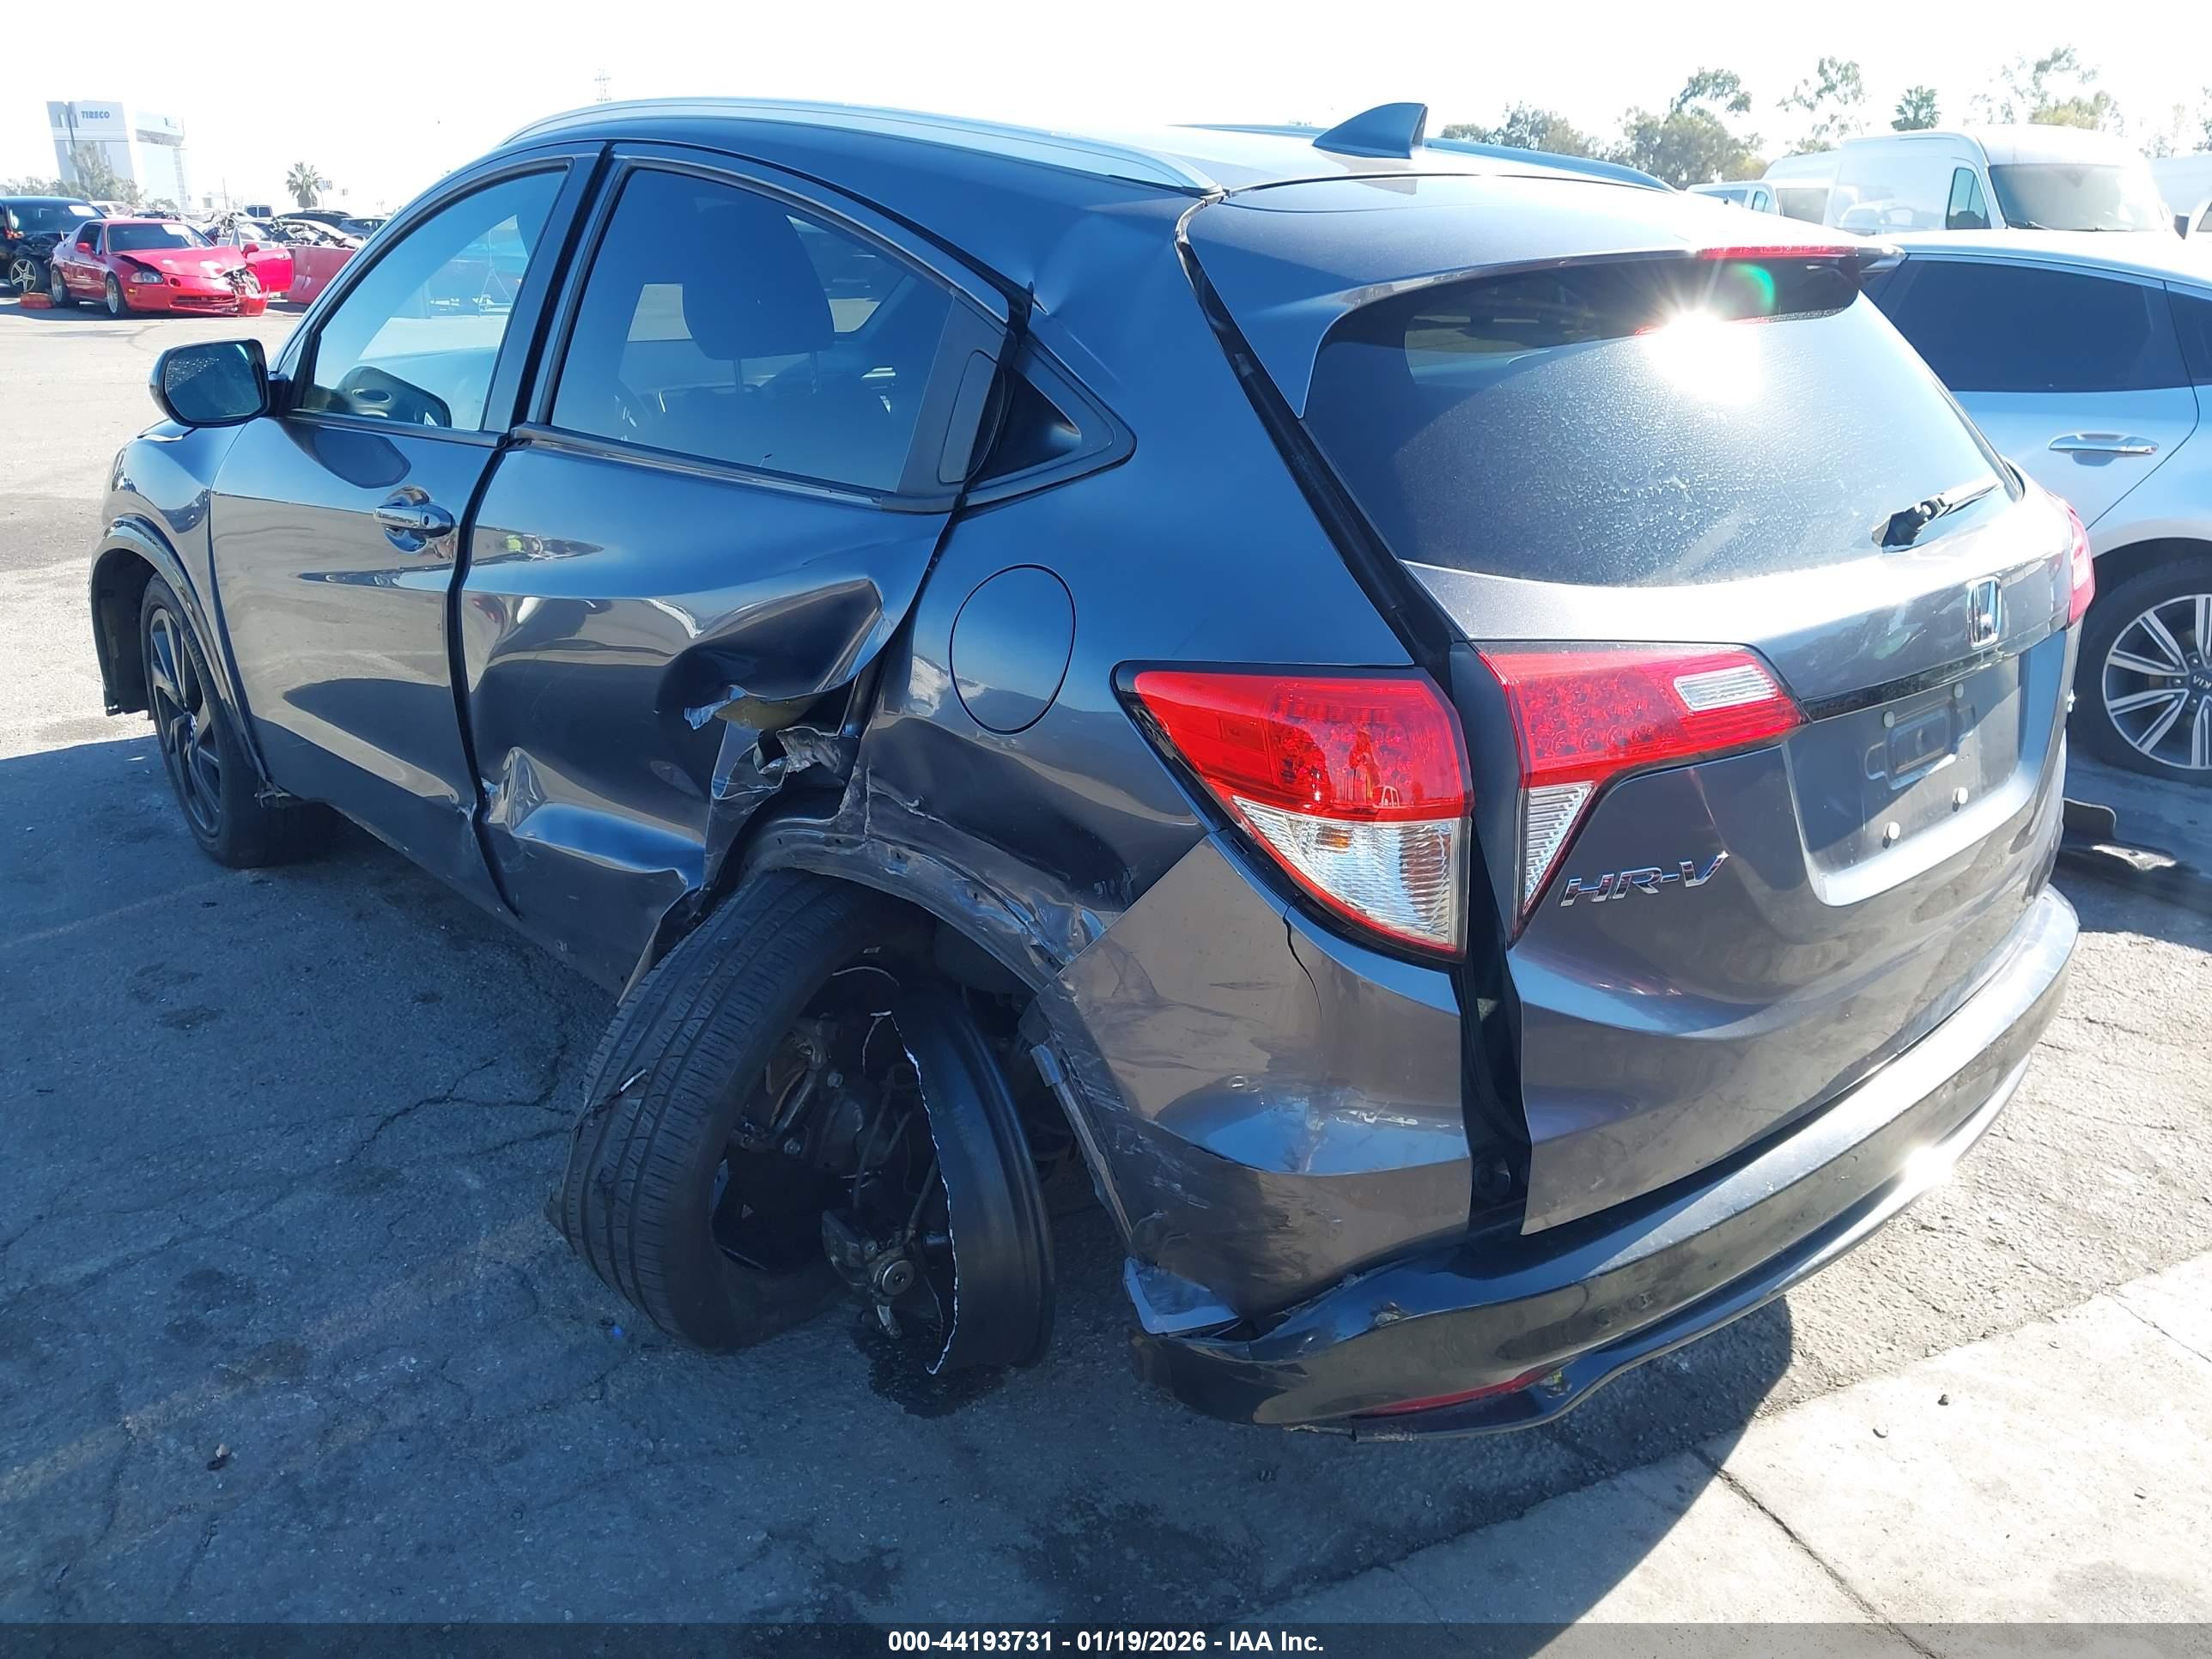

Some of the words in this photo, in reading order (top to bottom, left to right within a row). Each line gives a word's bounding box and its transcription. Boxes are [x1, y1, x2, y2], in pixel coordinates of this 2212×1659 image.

[81, 110, 110, 118] TIRECO
[2192, 675, 2212, 690] KIA
[1560, 850, 1730, 907] HR-V
